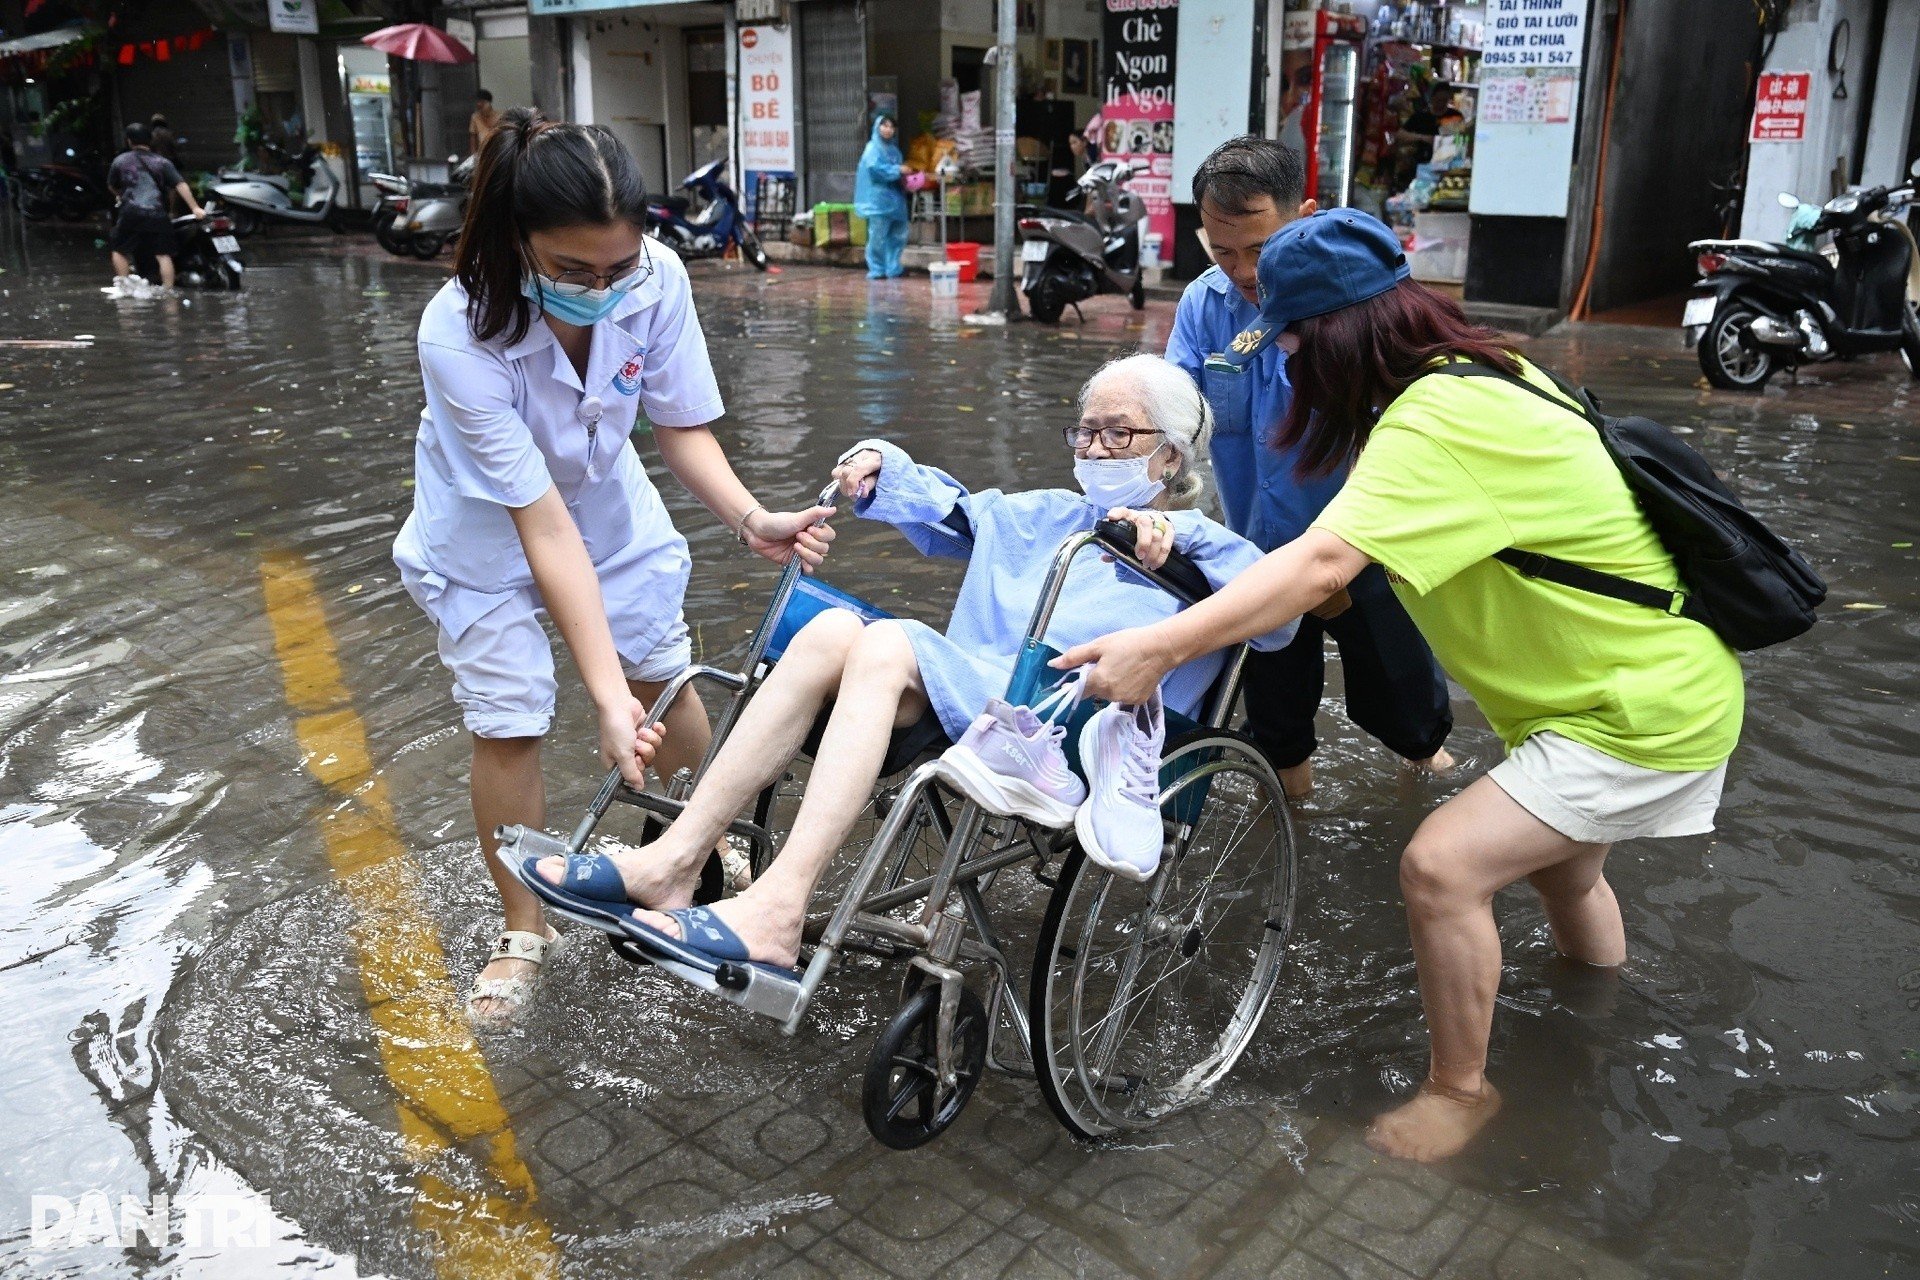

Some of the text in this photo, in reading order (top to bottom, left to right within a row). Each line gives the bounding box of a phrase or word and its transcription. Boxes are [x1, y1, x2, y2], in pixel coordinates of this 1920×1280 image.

[1122, 13, 1162, 43] Chè
[1524, 16, 1543, 28] TAI
[1494, 34, 1565, 46] NEM CHUA
[1115, 50, 1167, 81] Ngon
[1484, 51, 1573, 63] 0945 341 547
[1125, 82, 1174, 114] Ngọt
[752, 99, 780, 119] BÊ
